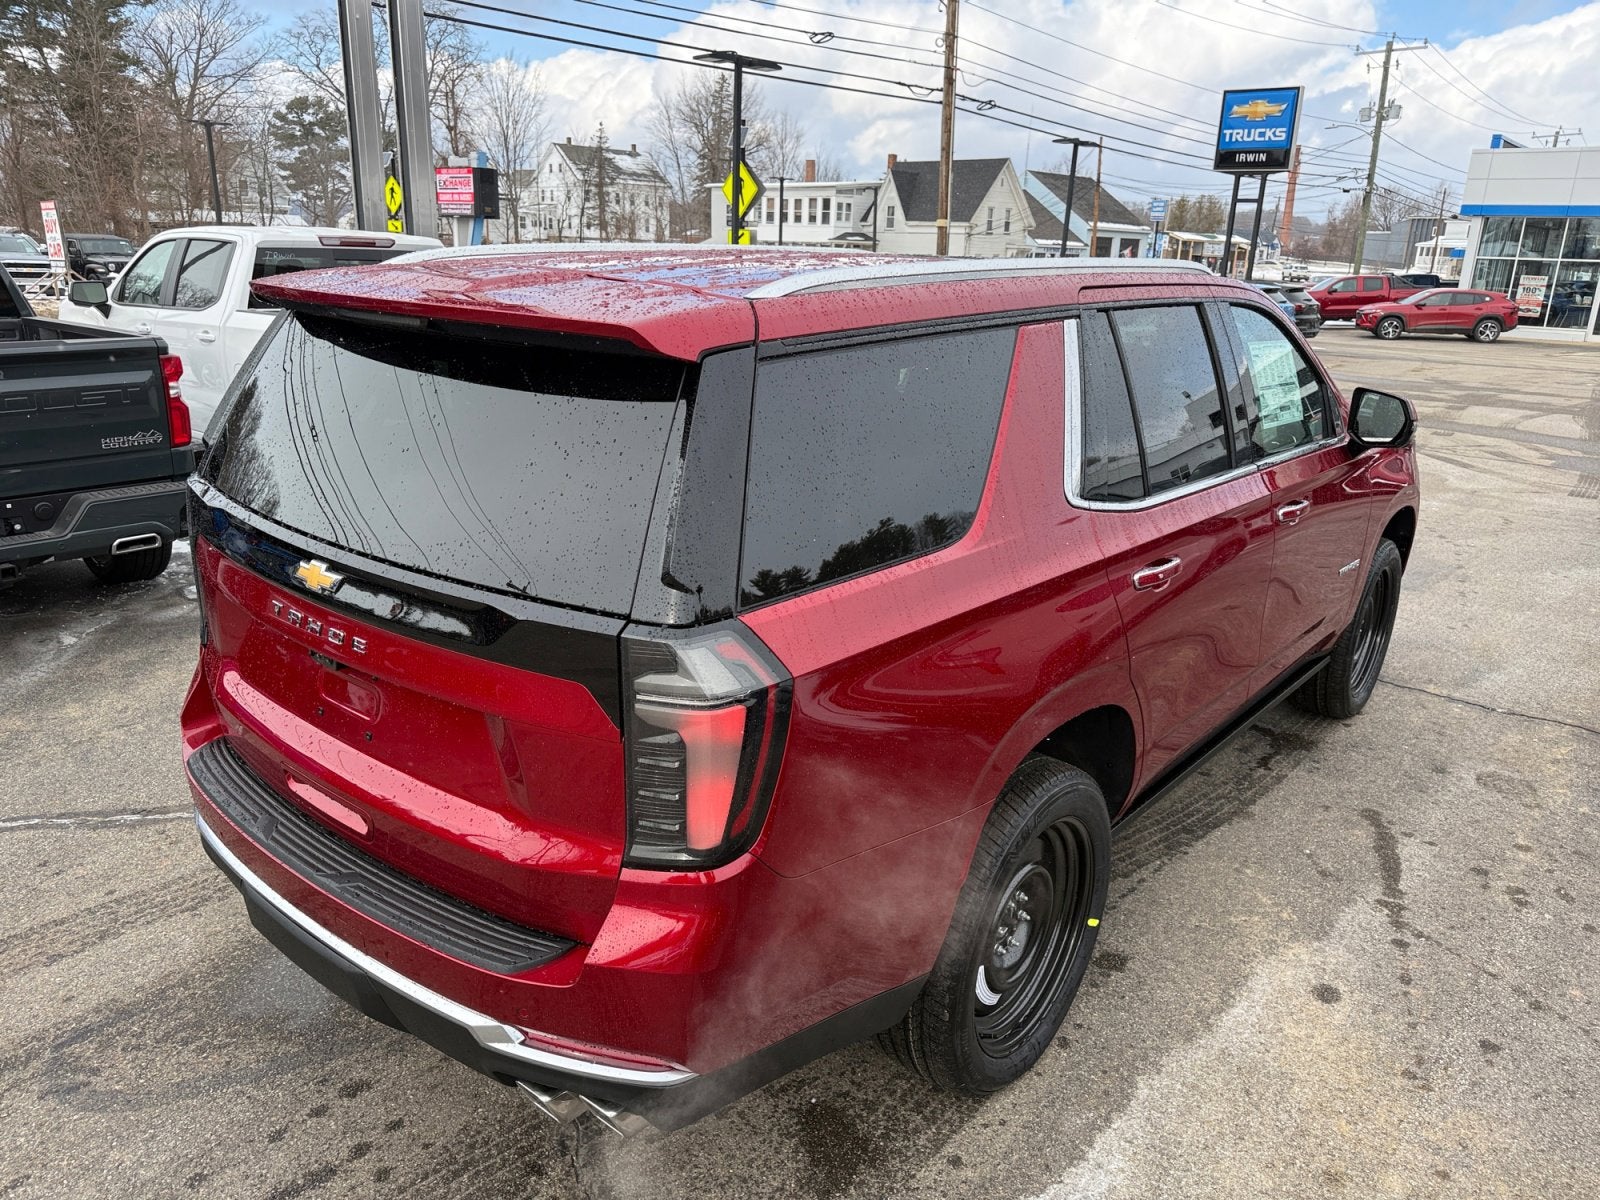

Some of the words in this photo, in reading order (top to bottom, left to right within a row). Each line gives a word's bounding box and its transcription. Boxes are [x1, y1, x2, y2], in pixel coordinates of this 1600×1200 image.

[1223, 127, 1287, 142] TRUCKS
[1235, 152, 1267, 162] IRWIN
[438, 179, 472, 188] EXCHANGE
[45, 218, 58, 234] BUY
[49, 243, 64, 258] CAR
[102, 437, 163, 449] COUNTRY
[271, 600, 368, 654] TAHOE
